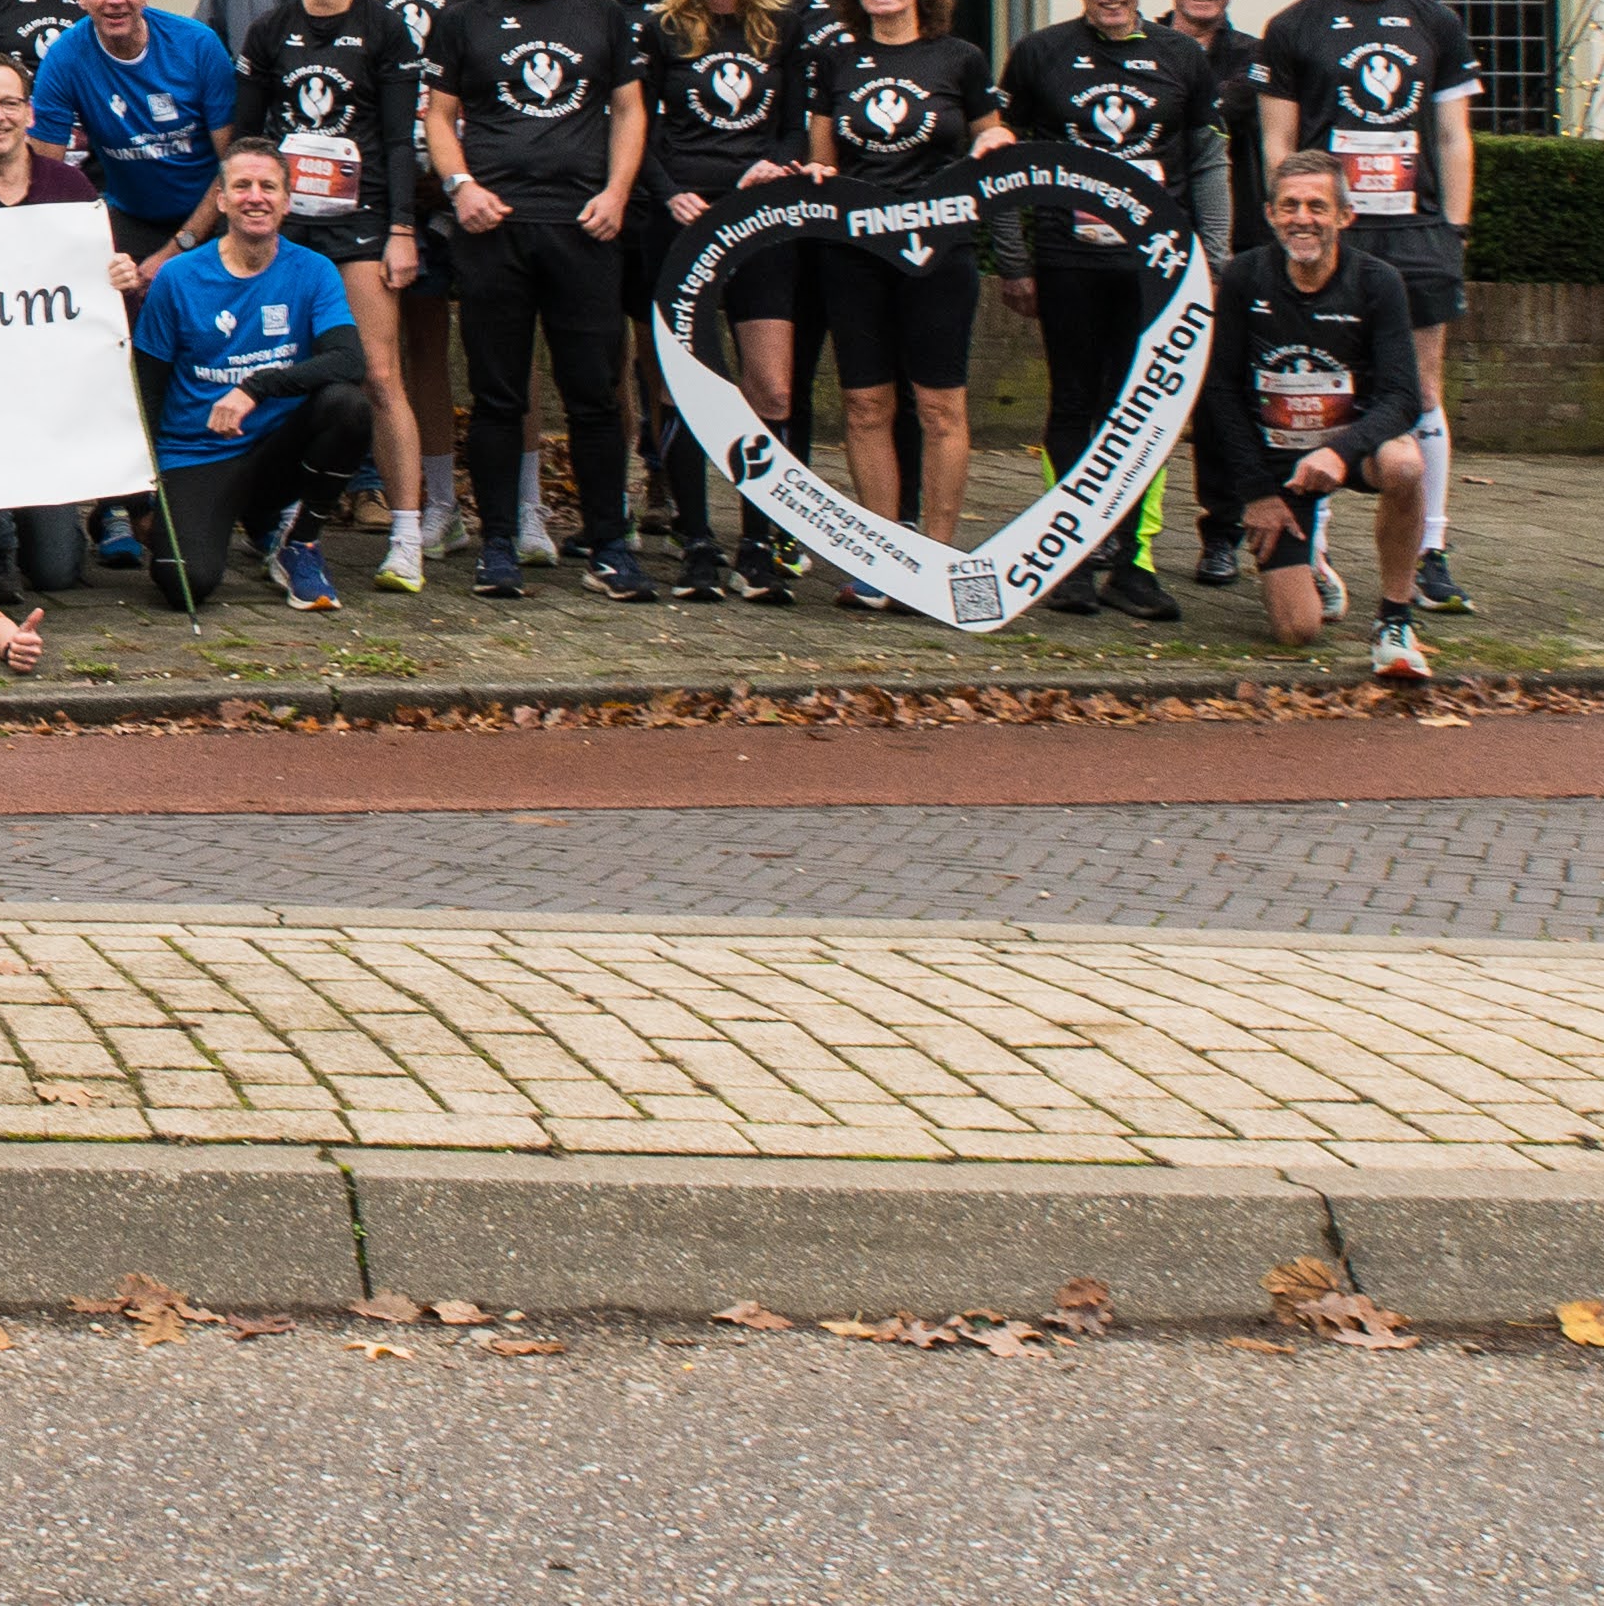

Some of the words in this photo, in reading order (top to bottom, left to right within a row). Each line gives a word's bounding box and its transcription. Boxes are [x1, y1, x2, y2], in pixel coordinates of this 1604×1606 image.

[847, 194, 980, 238] FINISHER
[978, 171, 1031, 201] Kom
[1031, 167, 1052, 188] in
[1056, 164, 1153, 227] beweging
[690, 242, 728, 296] tegen
[715, 199, 839, 249] Huntington
[1006, 508, 1085, 597] Stop
[1060, 300, 1216, 507] huntington
[1100, 424, 1167, 521] www.cthsport.nl
[768, 481, 878, 568] Huntington
[782, 466, 923, 576] Campagneteam
[945, 557, 994, 576] #CTH
